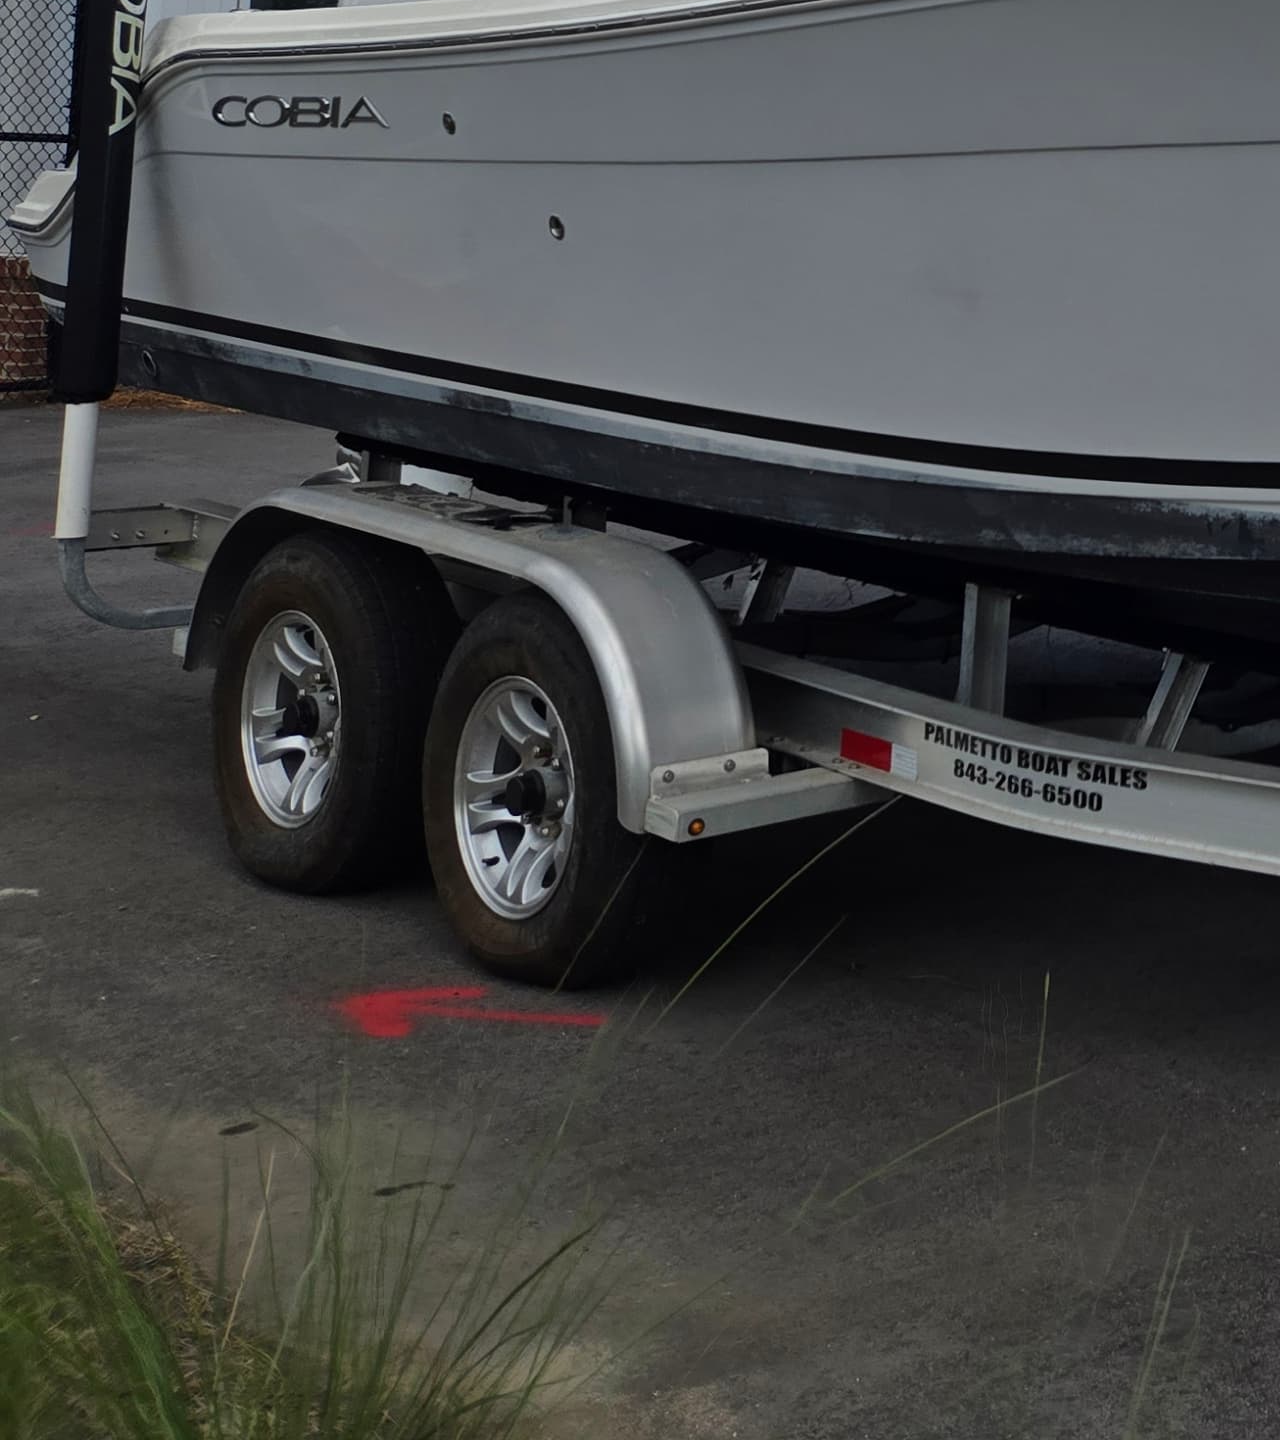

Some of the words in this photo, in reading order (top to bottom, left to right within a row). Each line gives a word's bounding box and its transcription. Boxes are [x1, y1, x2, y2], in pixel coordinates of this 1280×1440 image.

[212, 95, 390, 128] COBIA
[924, 722, 1012, 765] PALMETTO
[1017, 749, 1072, 778] BOAT
[1076, 760, 1148, 791] SALES
[953, 758, 1103, 812] 843-266-6500
